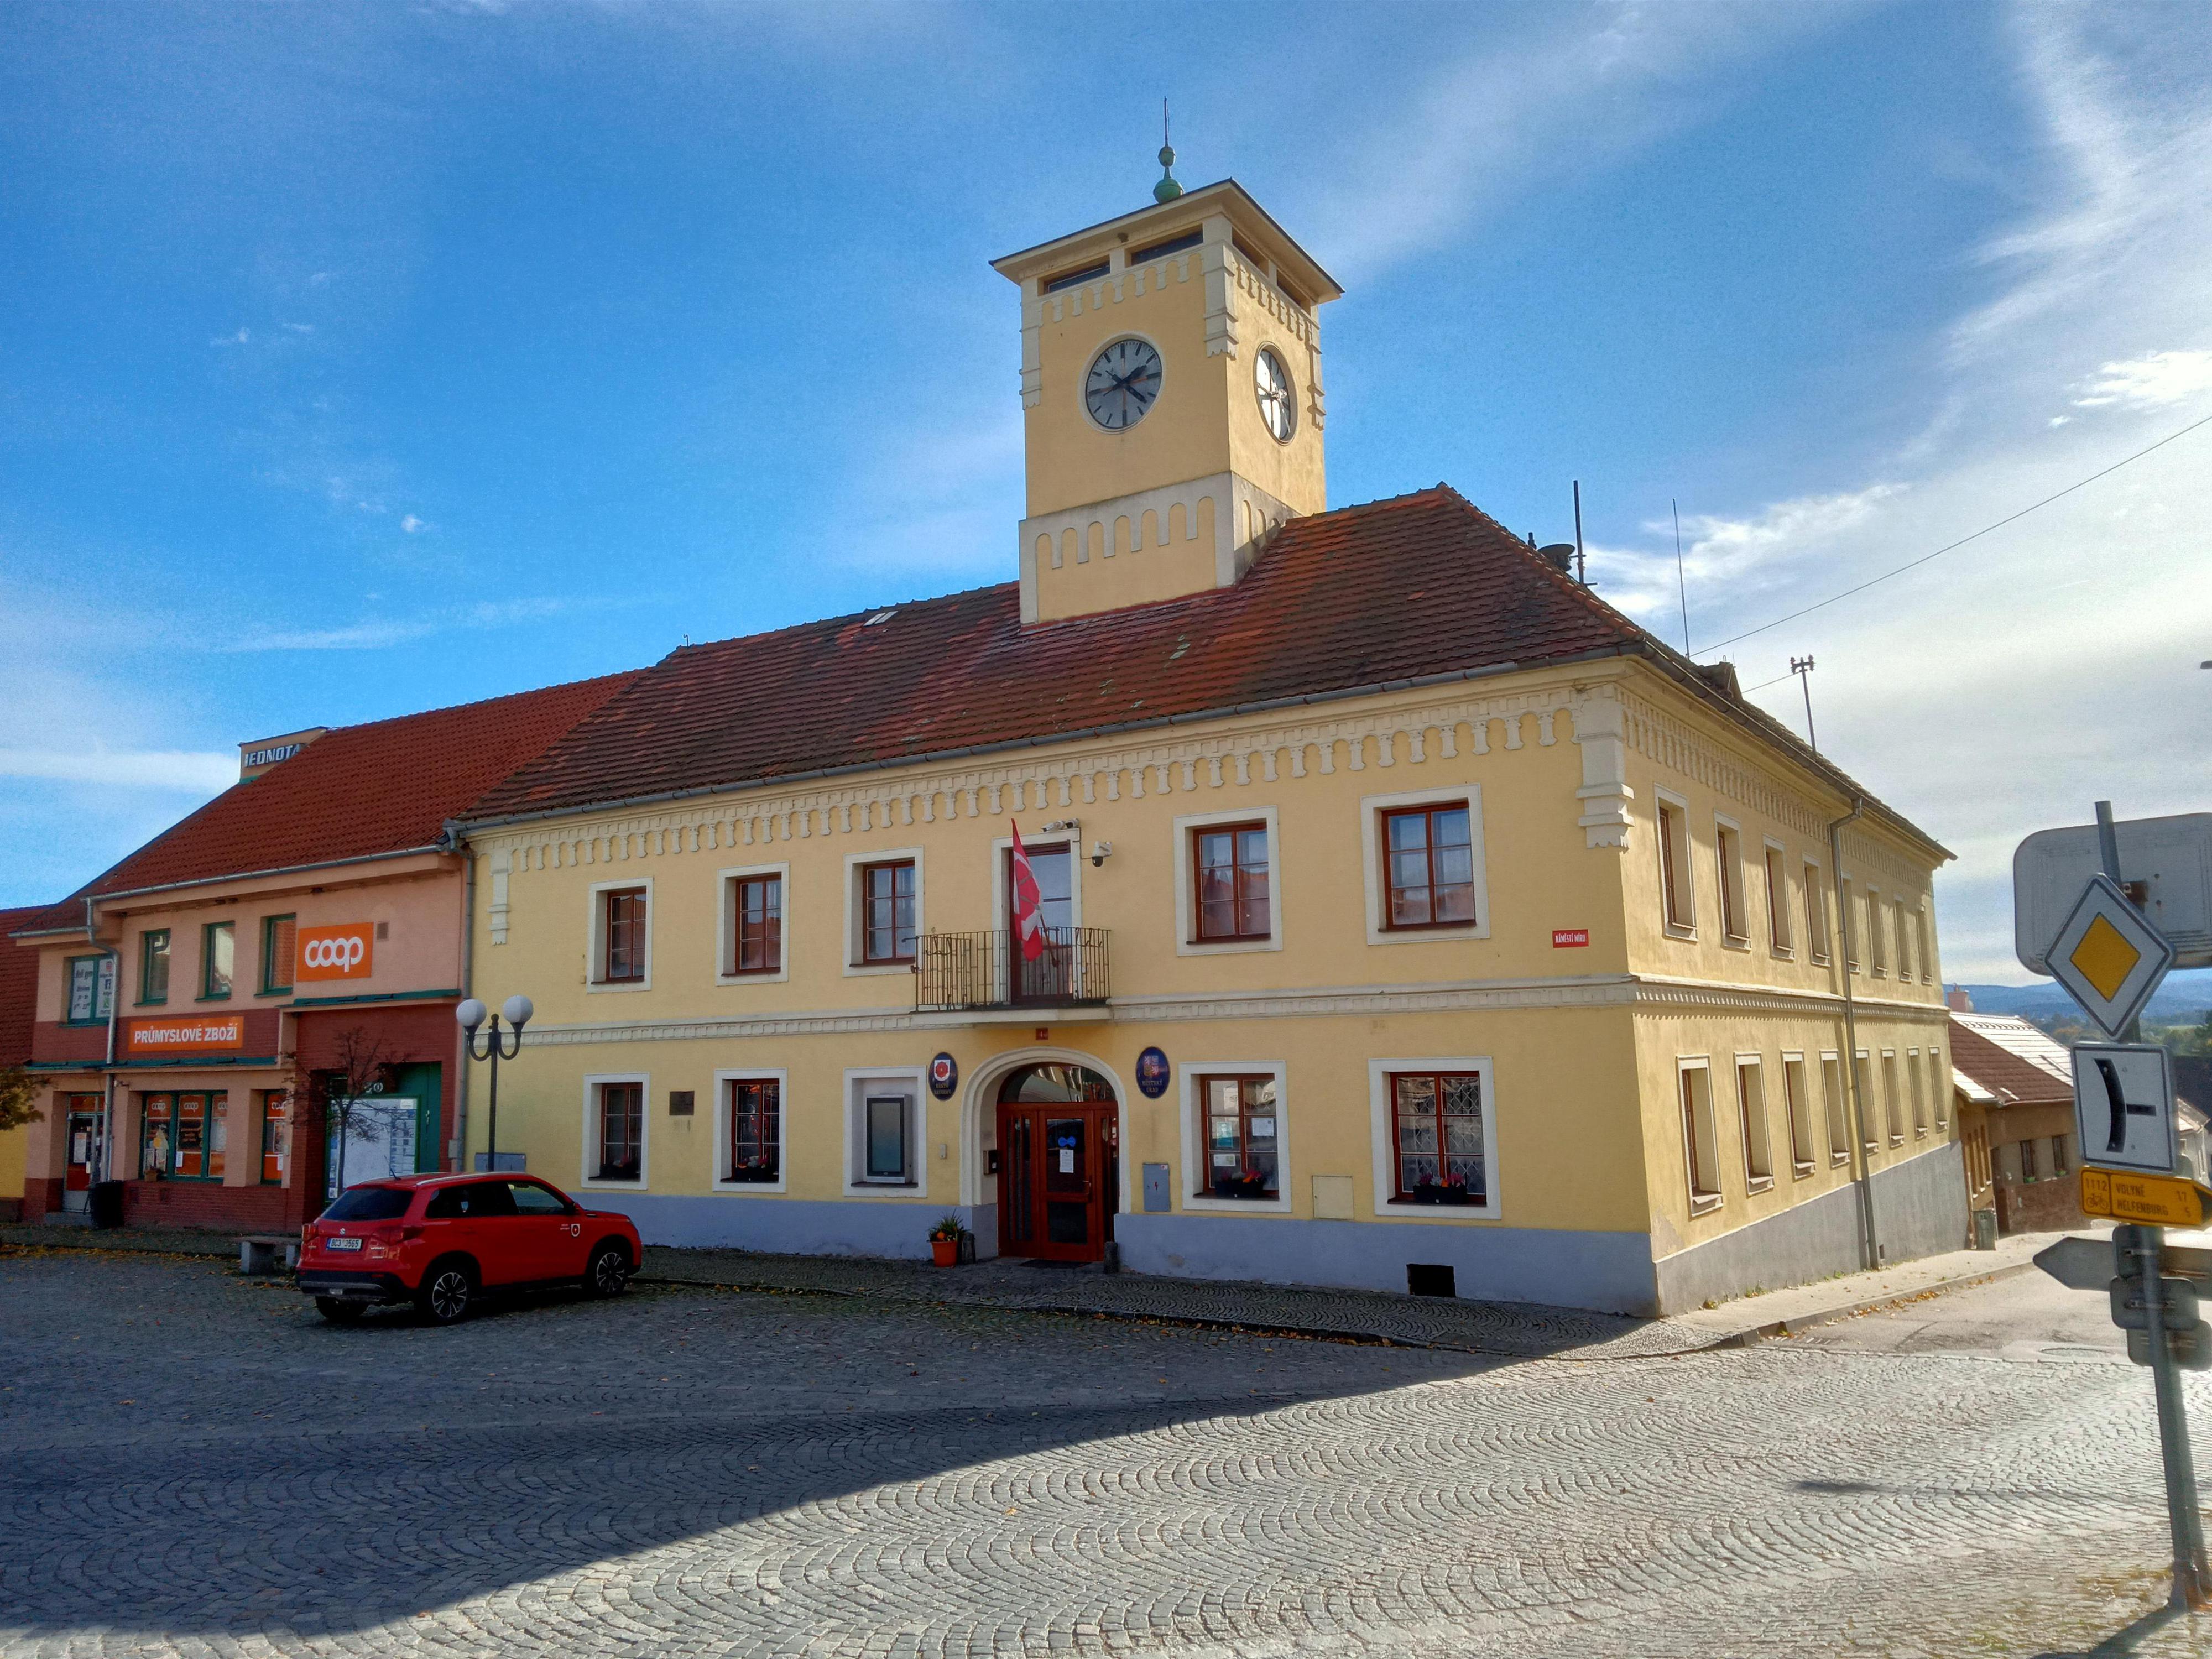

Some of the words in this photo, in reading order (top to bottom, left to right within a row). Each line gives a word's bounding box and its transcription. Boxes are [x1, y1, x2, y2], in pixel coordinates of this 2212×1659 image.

[305, 936, 364, 973] coop
[134, 1024, 202, 1044] PRŮMYSLOVÉ
[204, 1022, 238, 1041] ZBOŽÍ
[2085, 1178, 2107, 1192] 1112
[2117, 1199, 2169, 1216] HELFENBURG
